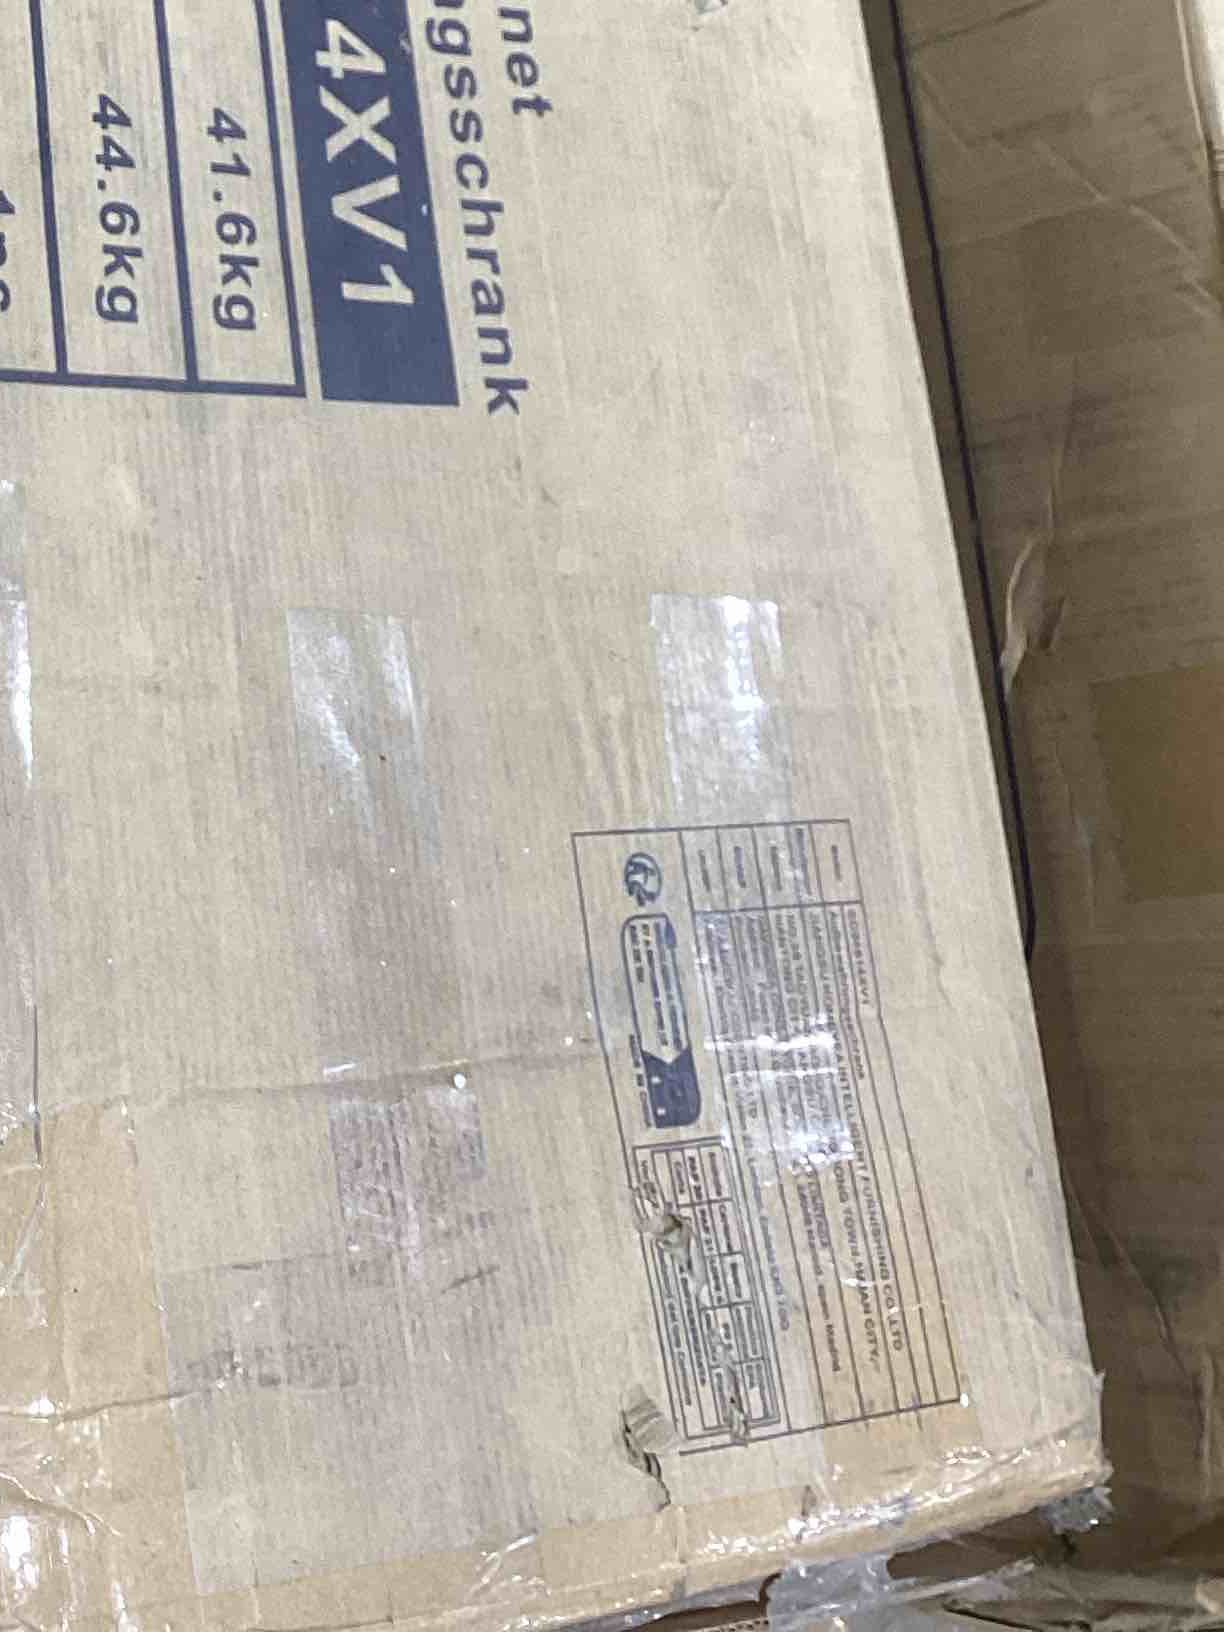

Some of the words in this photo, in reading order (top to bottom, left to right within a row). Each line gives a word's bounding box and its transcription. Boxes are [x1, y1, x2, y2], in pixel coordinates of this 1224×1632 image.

[91, 94, 143, 325] 44.6kg
[207, 107, 259, 332] 41.6kg
[859, 1173, 891, 1281] FURNISHING
